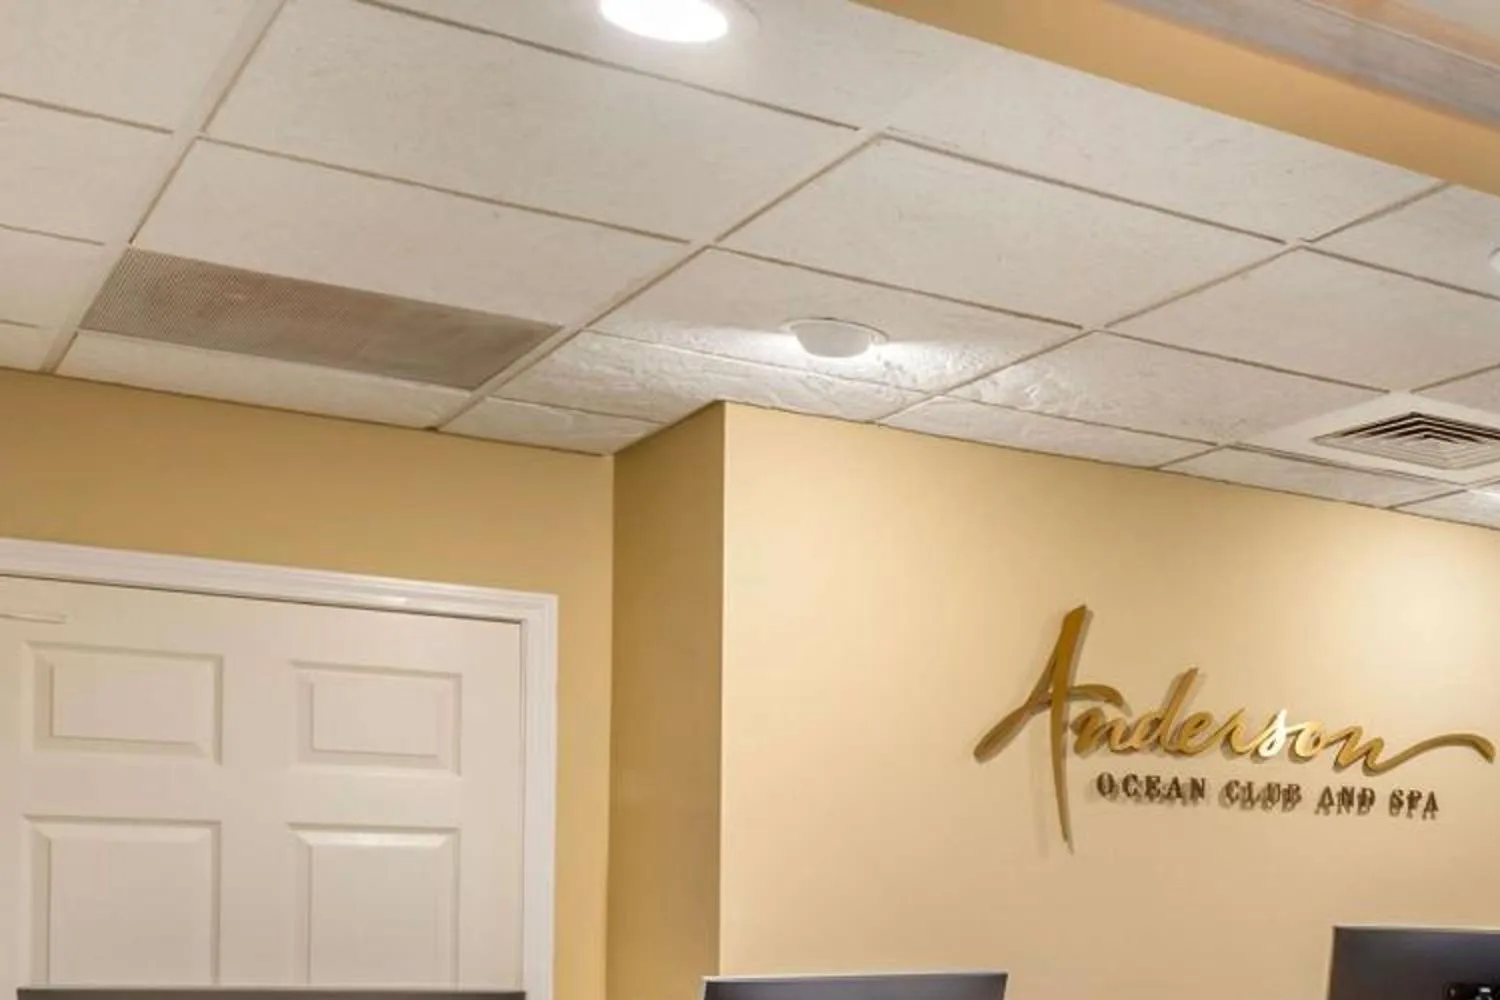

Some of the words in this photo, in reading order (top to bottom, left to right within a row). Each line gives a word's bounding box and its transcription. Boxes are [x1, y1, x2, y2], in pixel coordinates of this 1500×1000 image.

[973, 604, 1495, 854] Anderson
[1096, 771, 1207, 799] OCEAN
[1222, 779, 1302, 806] CLUB
[1317, 785, 1376, 811] AND
[1388, 789, 1440, 816] SPA
